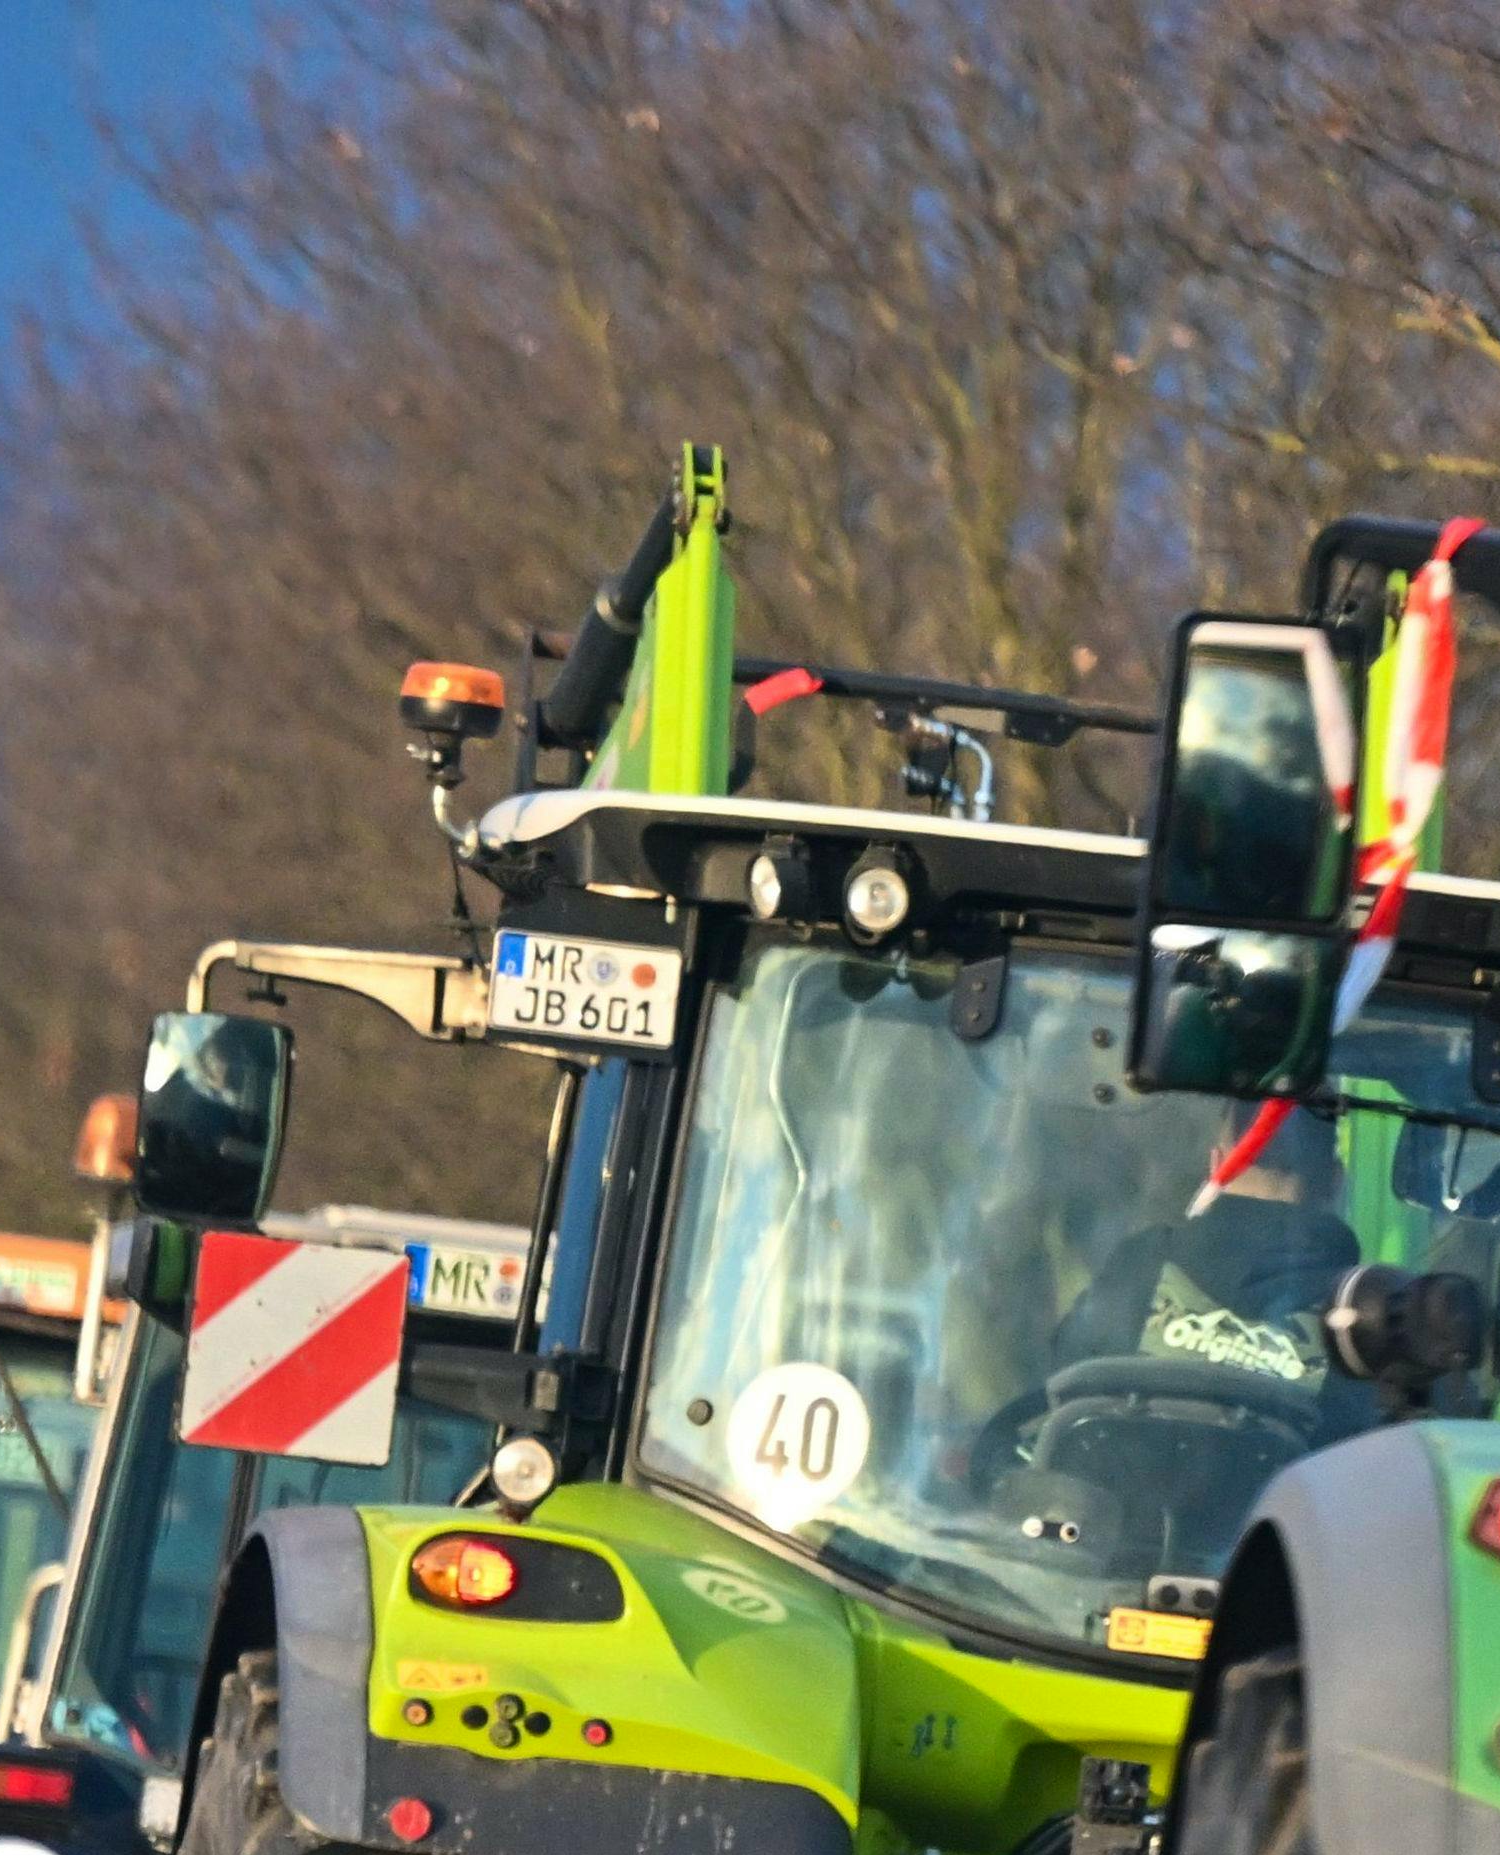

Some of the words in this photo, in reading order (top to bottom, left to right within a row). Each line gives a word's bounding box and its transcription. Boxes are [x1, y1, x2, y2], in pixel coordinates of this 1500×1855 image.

[531, 942, 583, 984] MR
[514, 987, 567, 1026] JB
[579, 993, 654, 1038] 601
[431, 1255, 490, 1303] MR
[755, 1393, 840, 1481] 40
